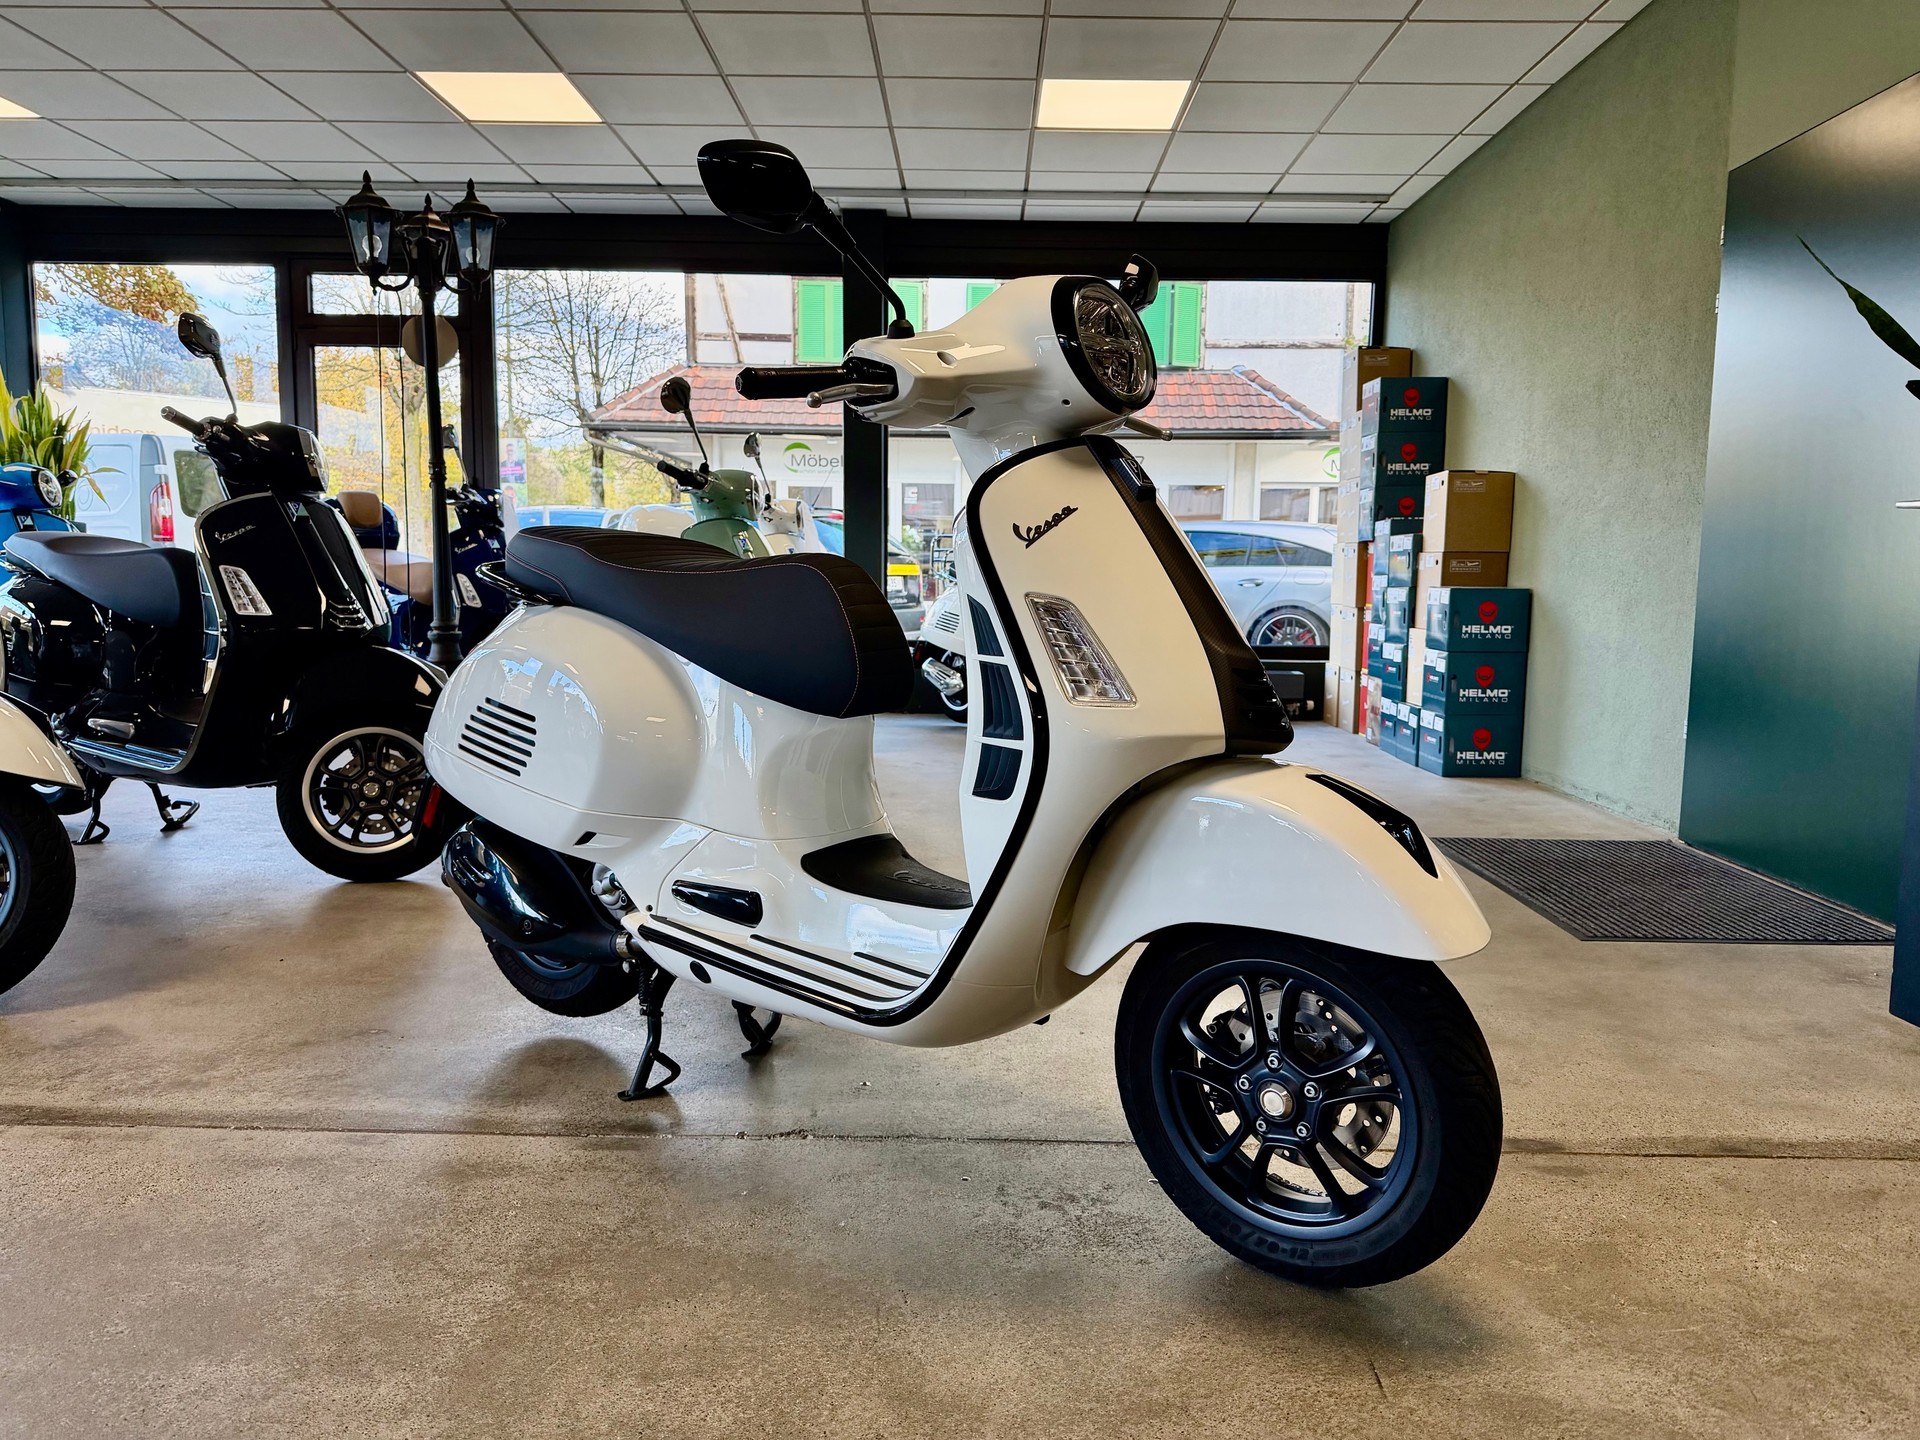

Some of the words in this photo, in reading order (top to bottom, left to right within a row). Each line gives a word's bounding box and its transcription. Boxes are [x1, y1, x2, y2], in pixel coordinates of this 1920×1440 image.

[1389, 408, 1432, 416] HELMO
[791, 454, 844, 468] Möbel
[1387, 463, 1429, 471] HELMO
[1012, 505, 1079, 549] Vespa
[215, 525, 256, 544] Vespa
[1461, 625, 1512, 634] HELMO
[1459, 689, 1508, 697] HELMO
[1456, 752, 1506, 760] HELMO
